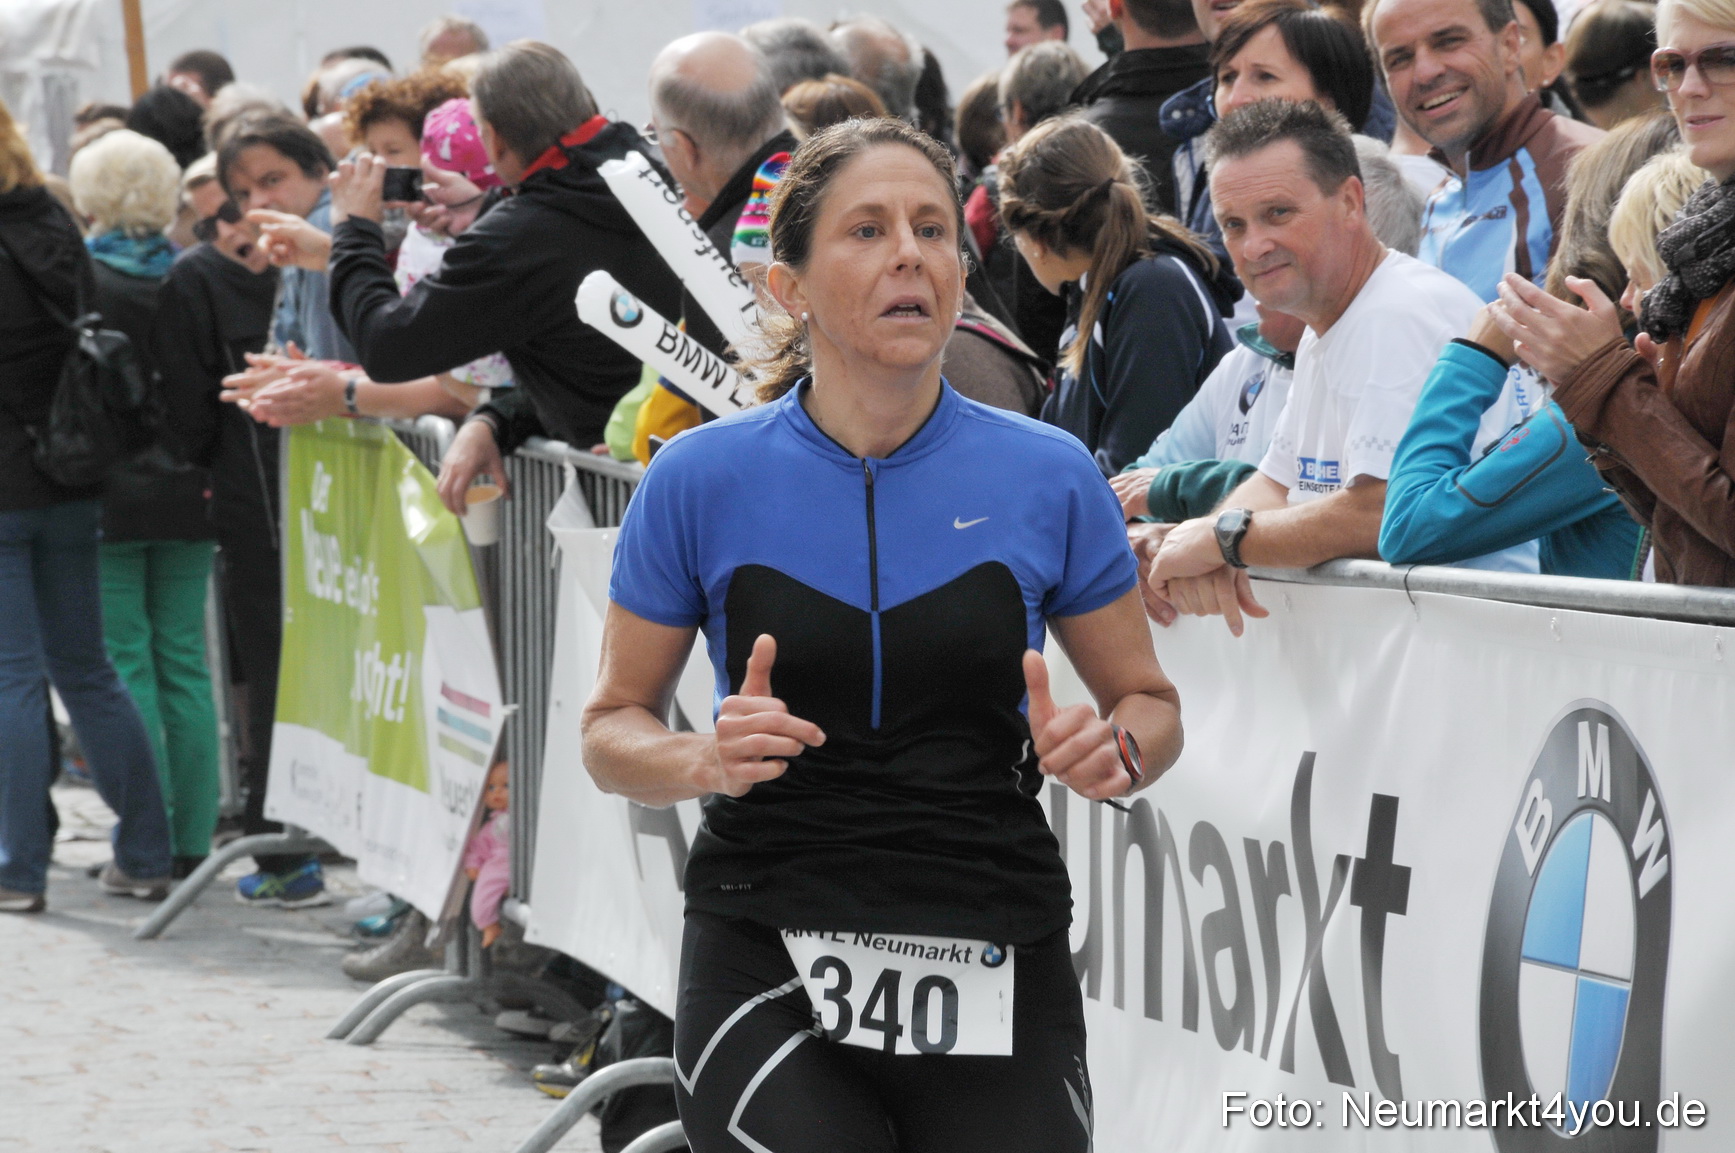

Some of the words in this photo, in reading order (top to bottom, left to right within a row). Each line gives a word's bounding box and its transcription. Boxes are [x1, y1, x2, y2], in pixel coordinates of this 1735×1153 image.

[655, 321, 728, 390] BMW
[1515, 720, 1669, 900] BMW
[853, 931, 973, 964] Neumarkt
[1050, 750, 1412, 1110] umarkt
[810, 955, 959, 1056] 340
